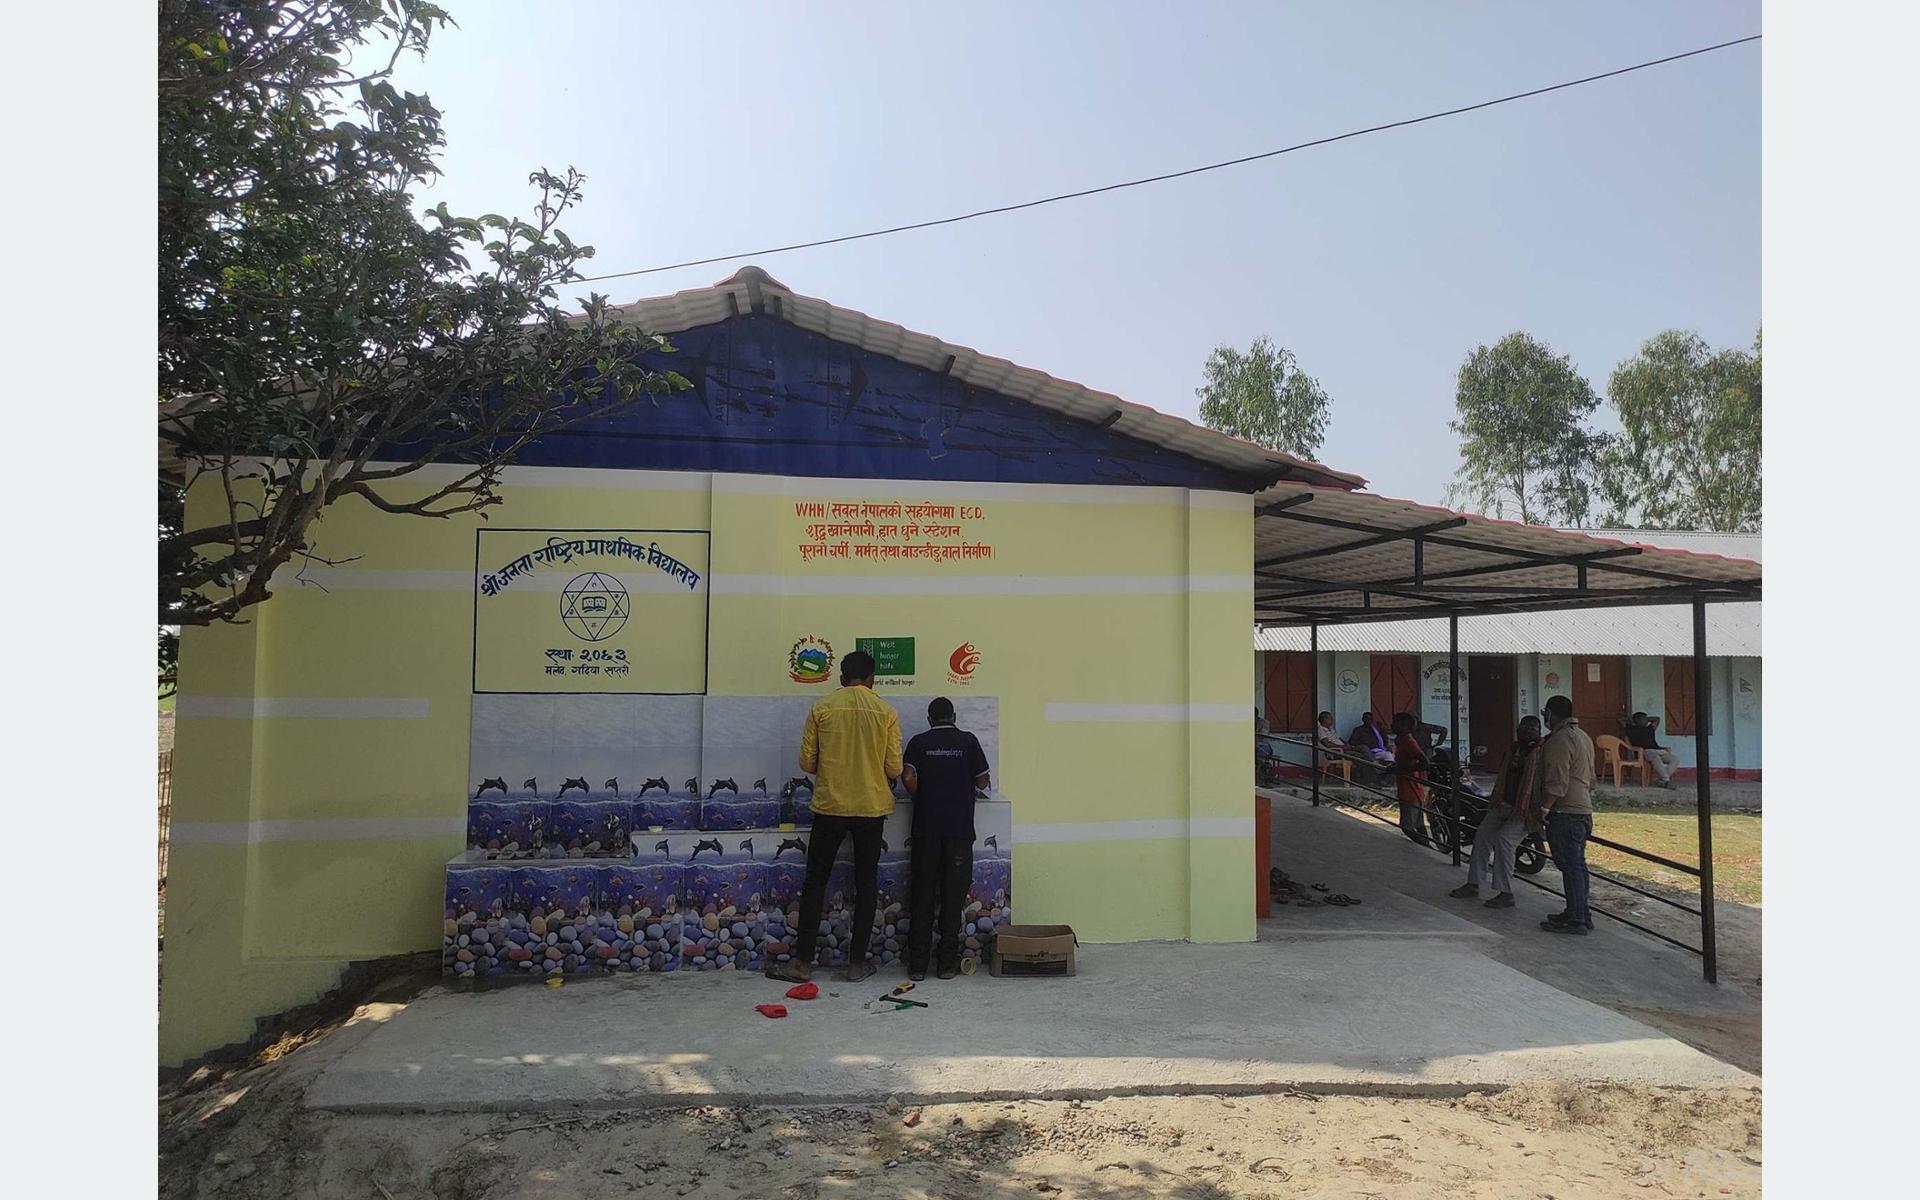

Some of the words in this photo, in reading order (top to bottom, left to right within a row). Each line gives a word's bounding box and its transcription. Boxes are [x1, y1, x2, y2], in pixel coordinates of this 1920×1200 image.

[905, 501, 955, 522] सहयोगमा
[901, 522, 919, 541] धुने
[880, 545, 900, 561] तथा
[586, 536, 646, 562] प्राथमिक
[648, 542, 701, 590] विद्यालय
[580, 649, 631, 665] २०६३
